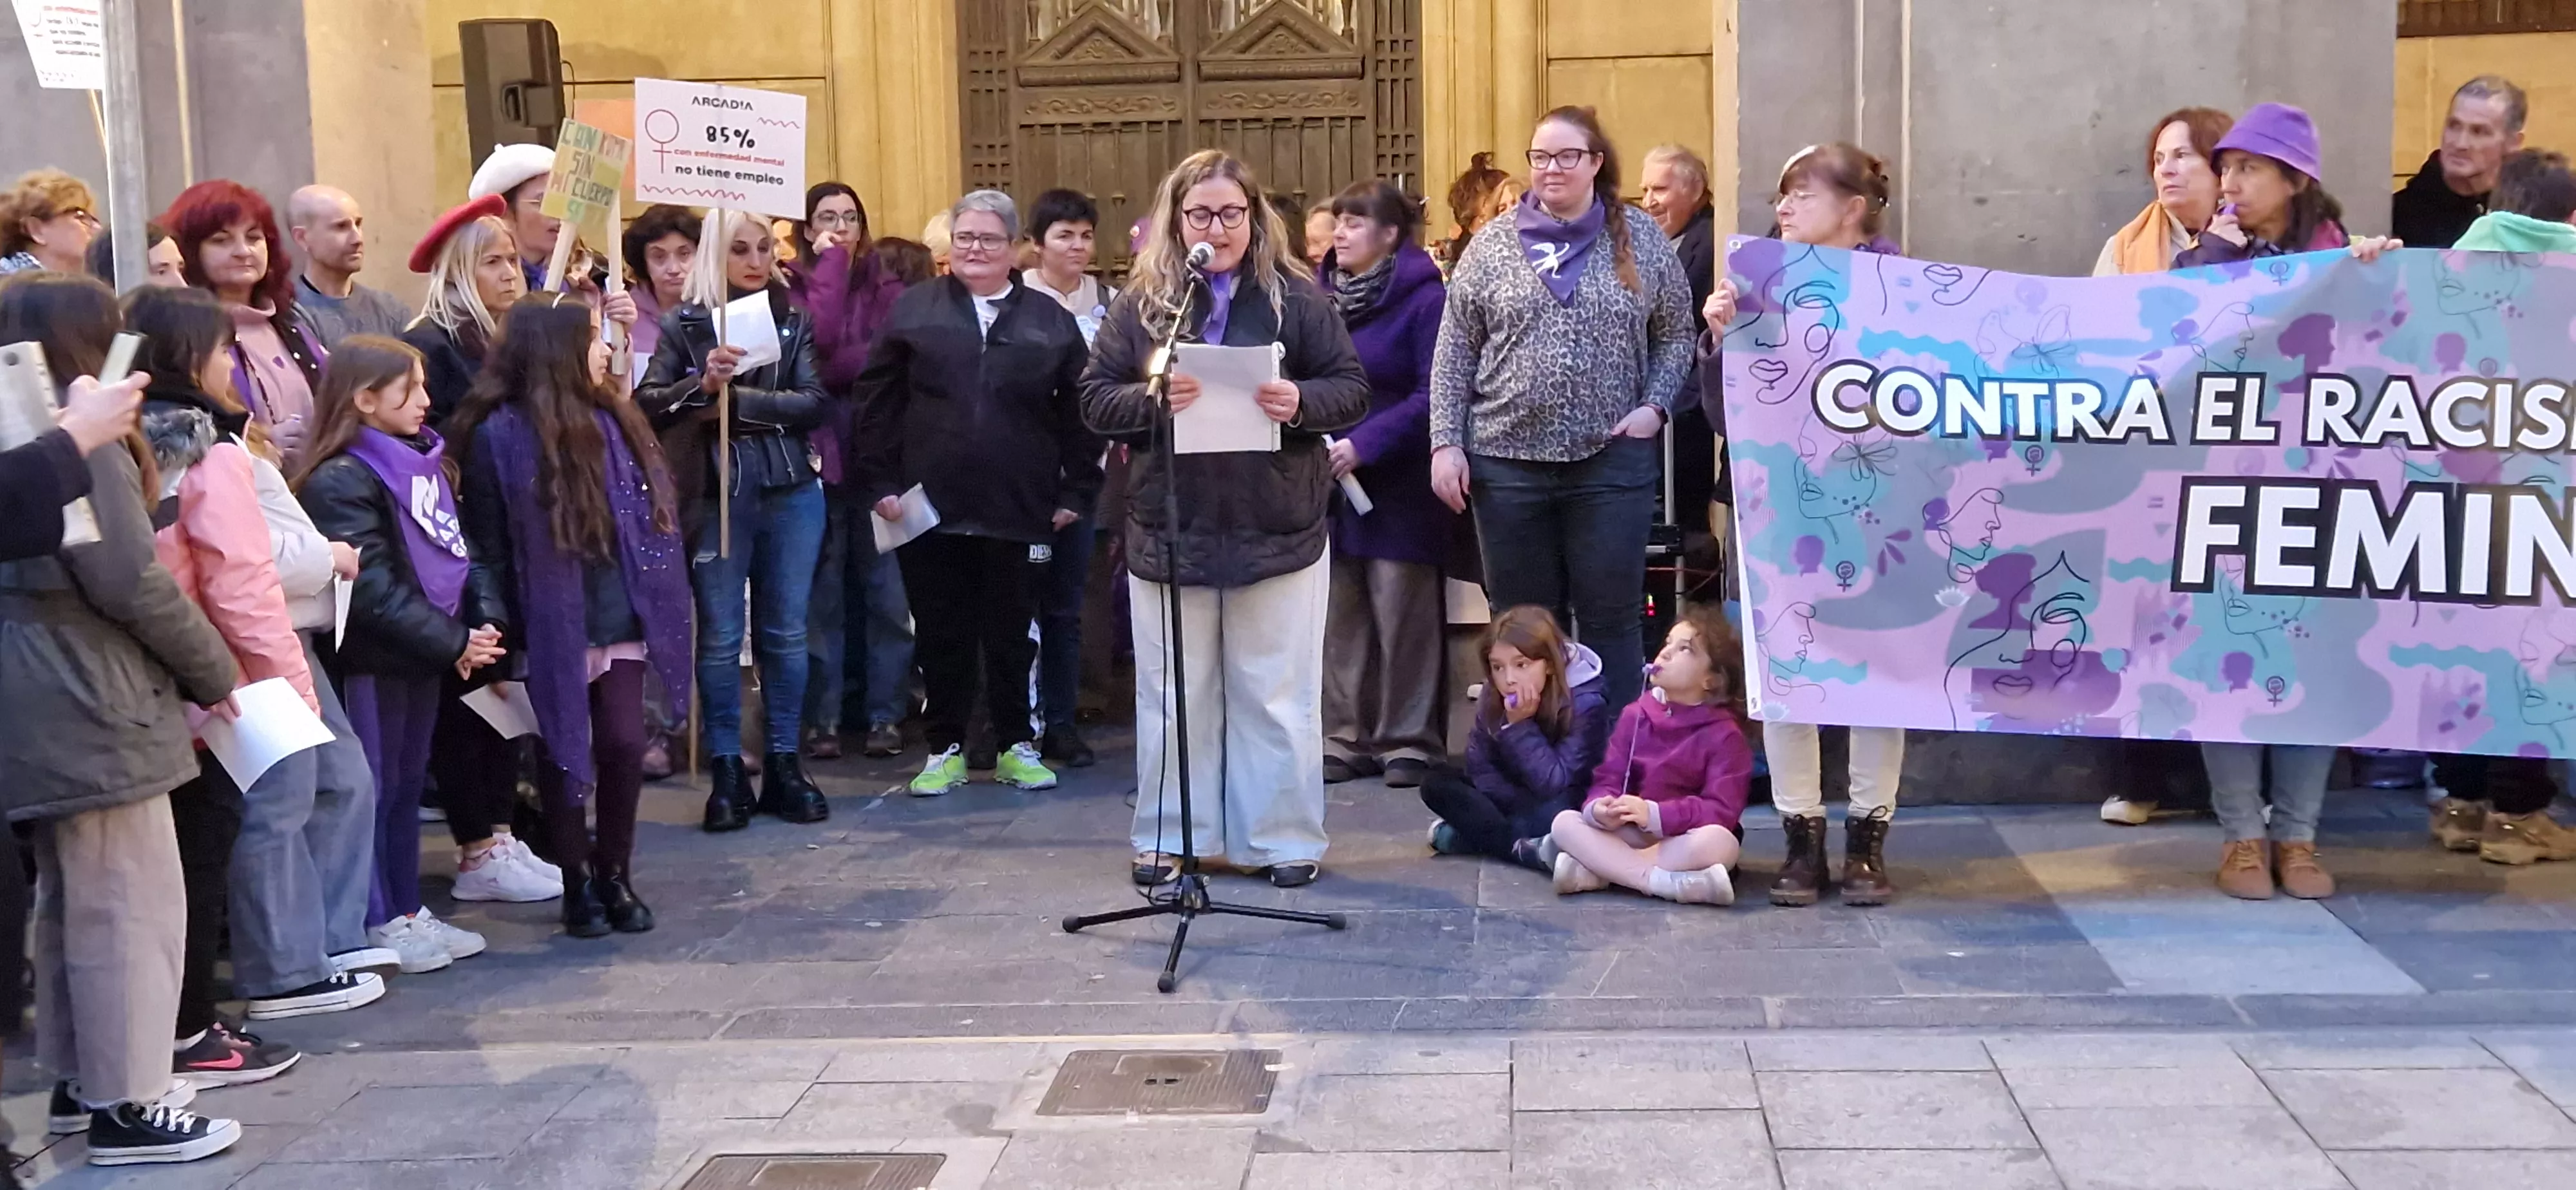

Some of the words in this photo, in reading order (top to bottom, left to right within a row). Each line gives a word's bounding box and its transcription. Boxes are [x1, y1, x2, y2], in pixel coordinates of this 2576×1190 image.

[706, 126, 755, 148] 85%
[694, 149, 752, 162] enfermedad
[753, 156, 784, 167] mental
[675, 165, 692, 175] no
[696, 165, 731, 178] tiene
[735, 172, 784, 185] empleo
[1813, 361, 2174, 444] CONTRA
[2192, 373, 2279, 444] EL
[2303, 375, 2575, 450] RACIS
[2174, 479, 2575, 603] FEMIN
